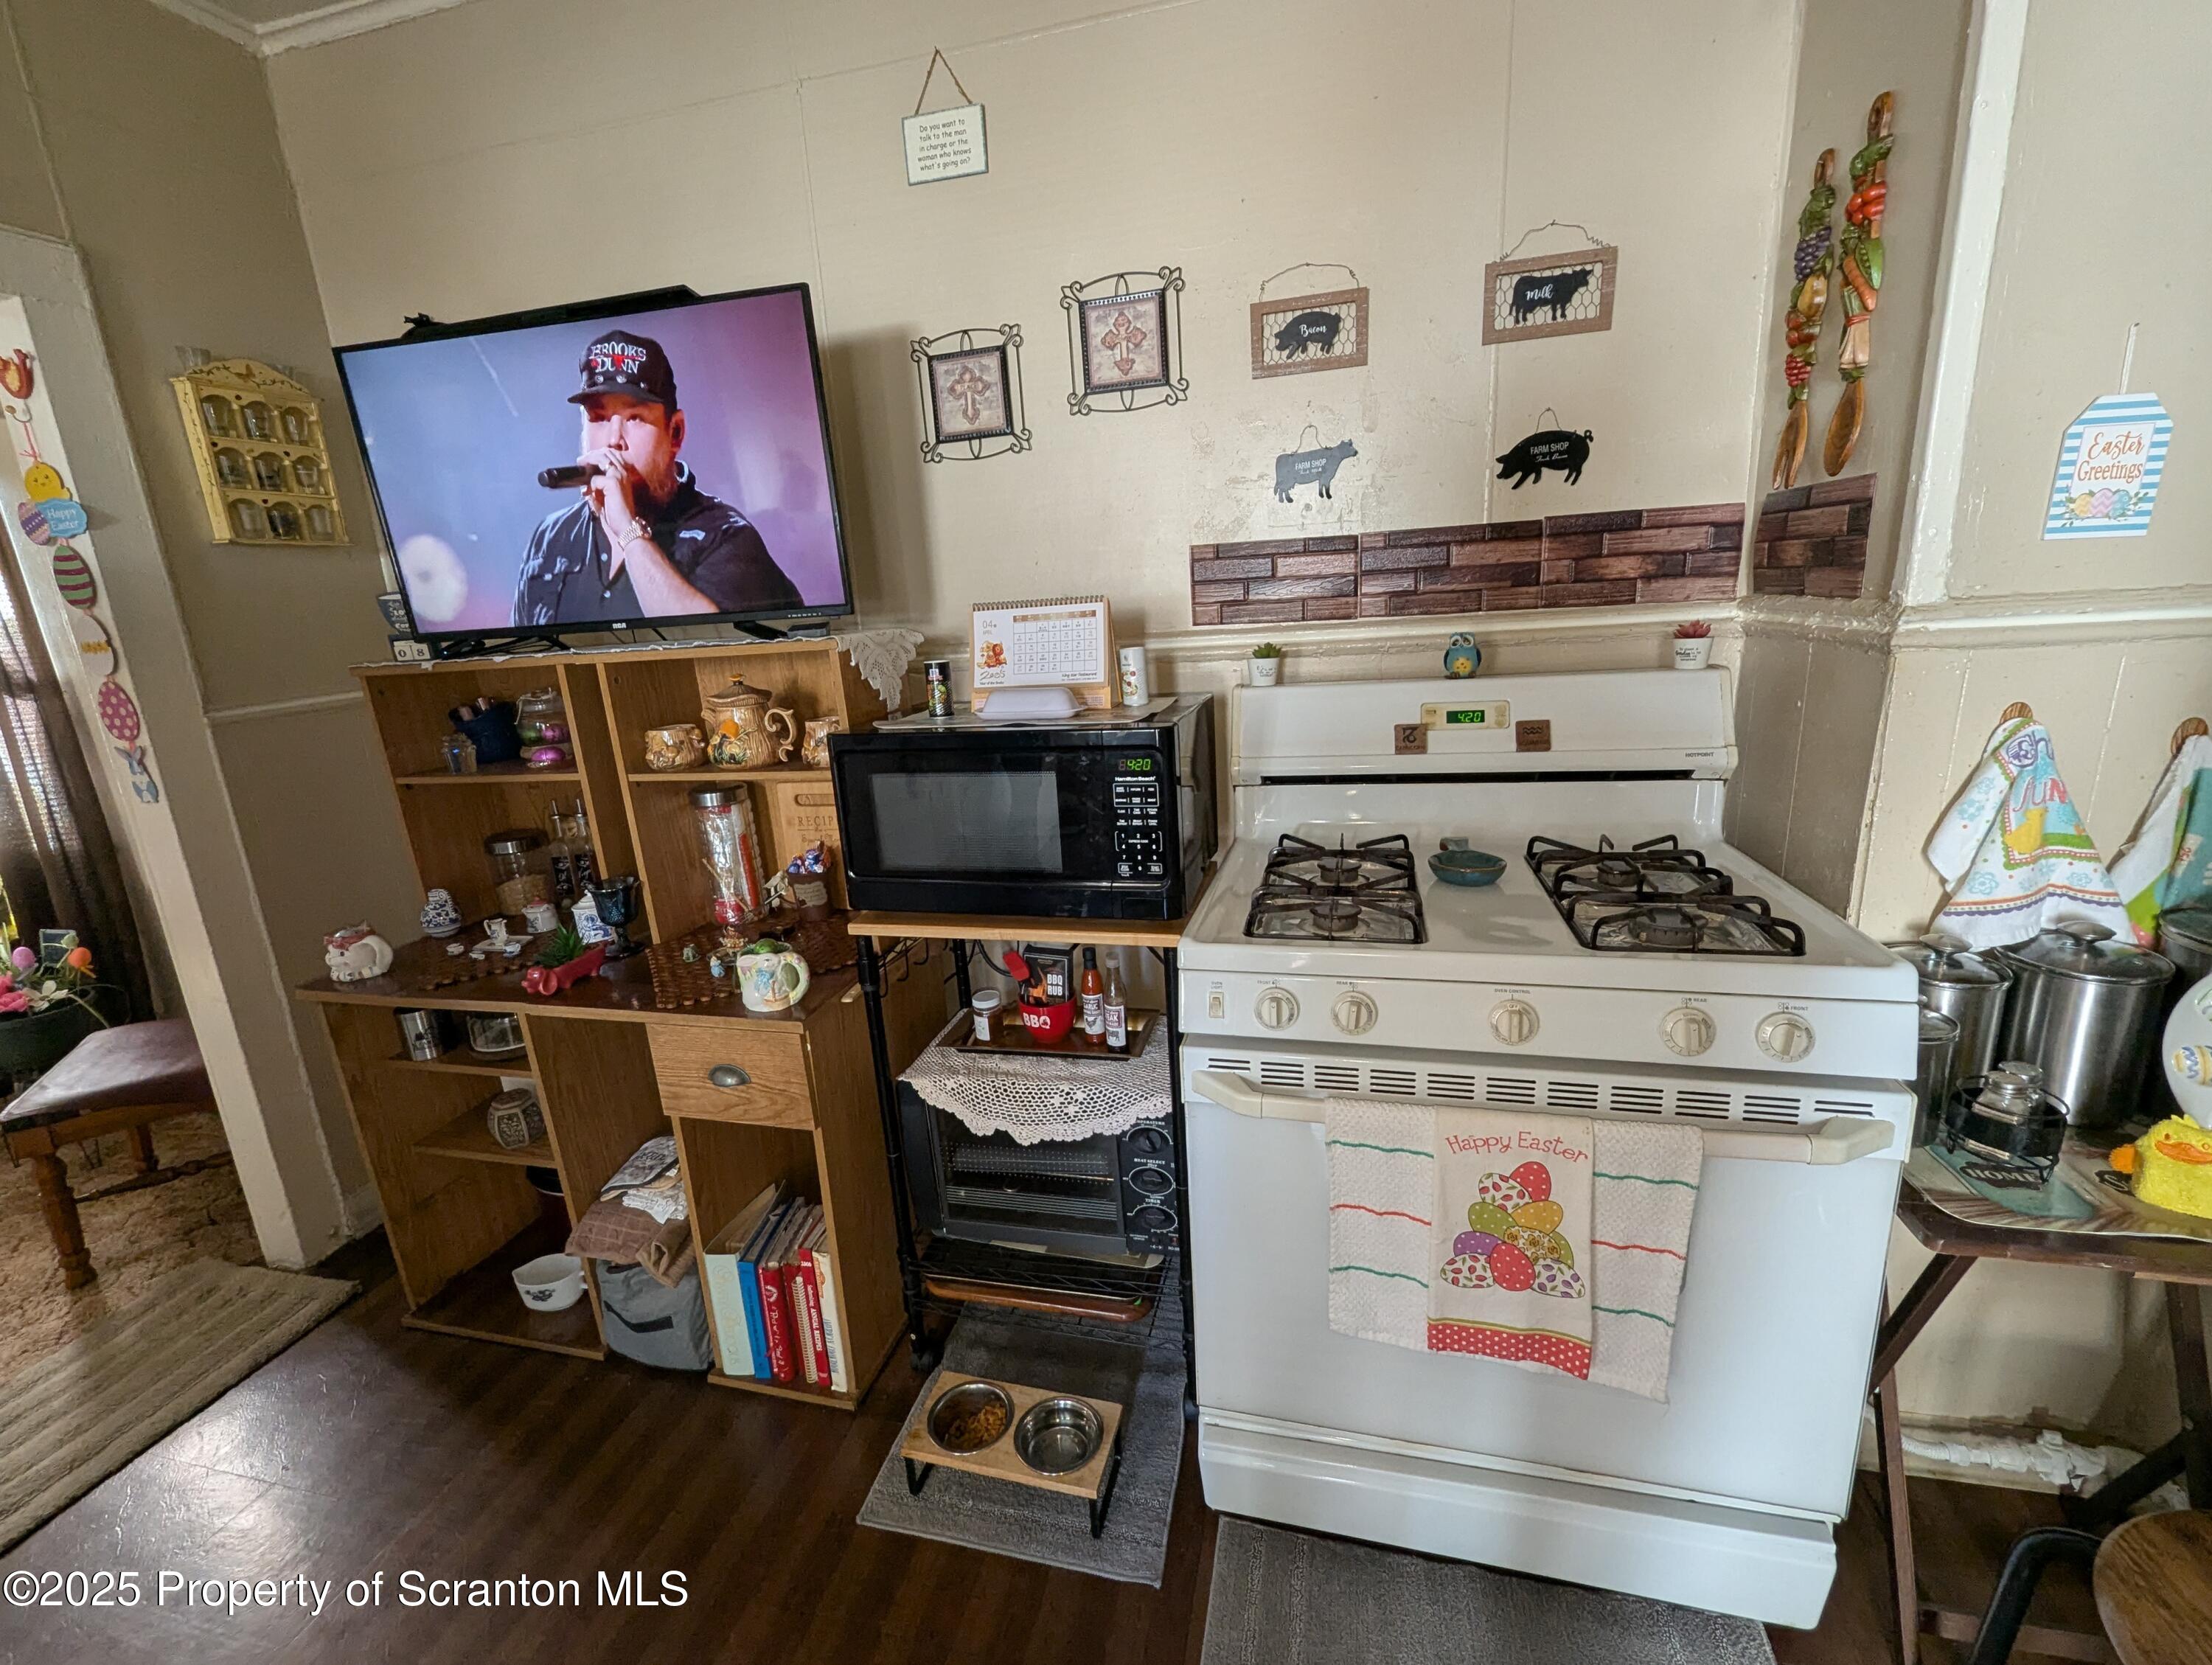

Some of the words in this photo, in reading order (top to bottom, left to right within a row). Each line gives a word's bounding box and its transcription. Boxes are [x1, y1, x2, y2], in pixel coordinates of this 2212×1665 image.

[929, 124, 940, 132] you
[941, 120, 956, 129] want
[920, 133, 932, 142] talk
[926, 142, 947, 151] charge
[918, 154, 938, 162] woman
[953, 148, 971, 157] knows
[920, 162, 940, 171] what's
[942, 160, 958, 170] going
[960, 156, 970, 165] on?
[1525, 284, 1554, 301] Milk
[1299, 324, 1327, 337] Bacon
[1530, 444, 1549, 455] FARM
[1550, 441, 1569, 452] SHOP
[2087, 431, 2144, 460] Easter
[1295, 461, 1311, 470] FARM
[1311, 458, 1326, 467] SHOP
[2077, 460, 2143, 484] Greetings
[51, 521, 79, 531] Easter
[797, 816, 834, 827] RECIP
[1047, 973, 1063, 986] BBQ
[1047, 984, 1063, 996] RUB
[1023, 1012, 1050, 1029] BBQ
[1445, 1134, 1512, 1155] Happy
[1517, 1130, 1589, 1163] Easter
[1965, 1168, 2037, 1182] HOME
